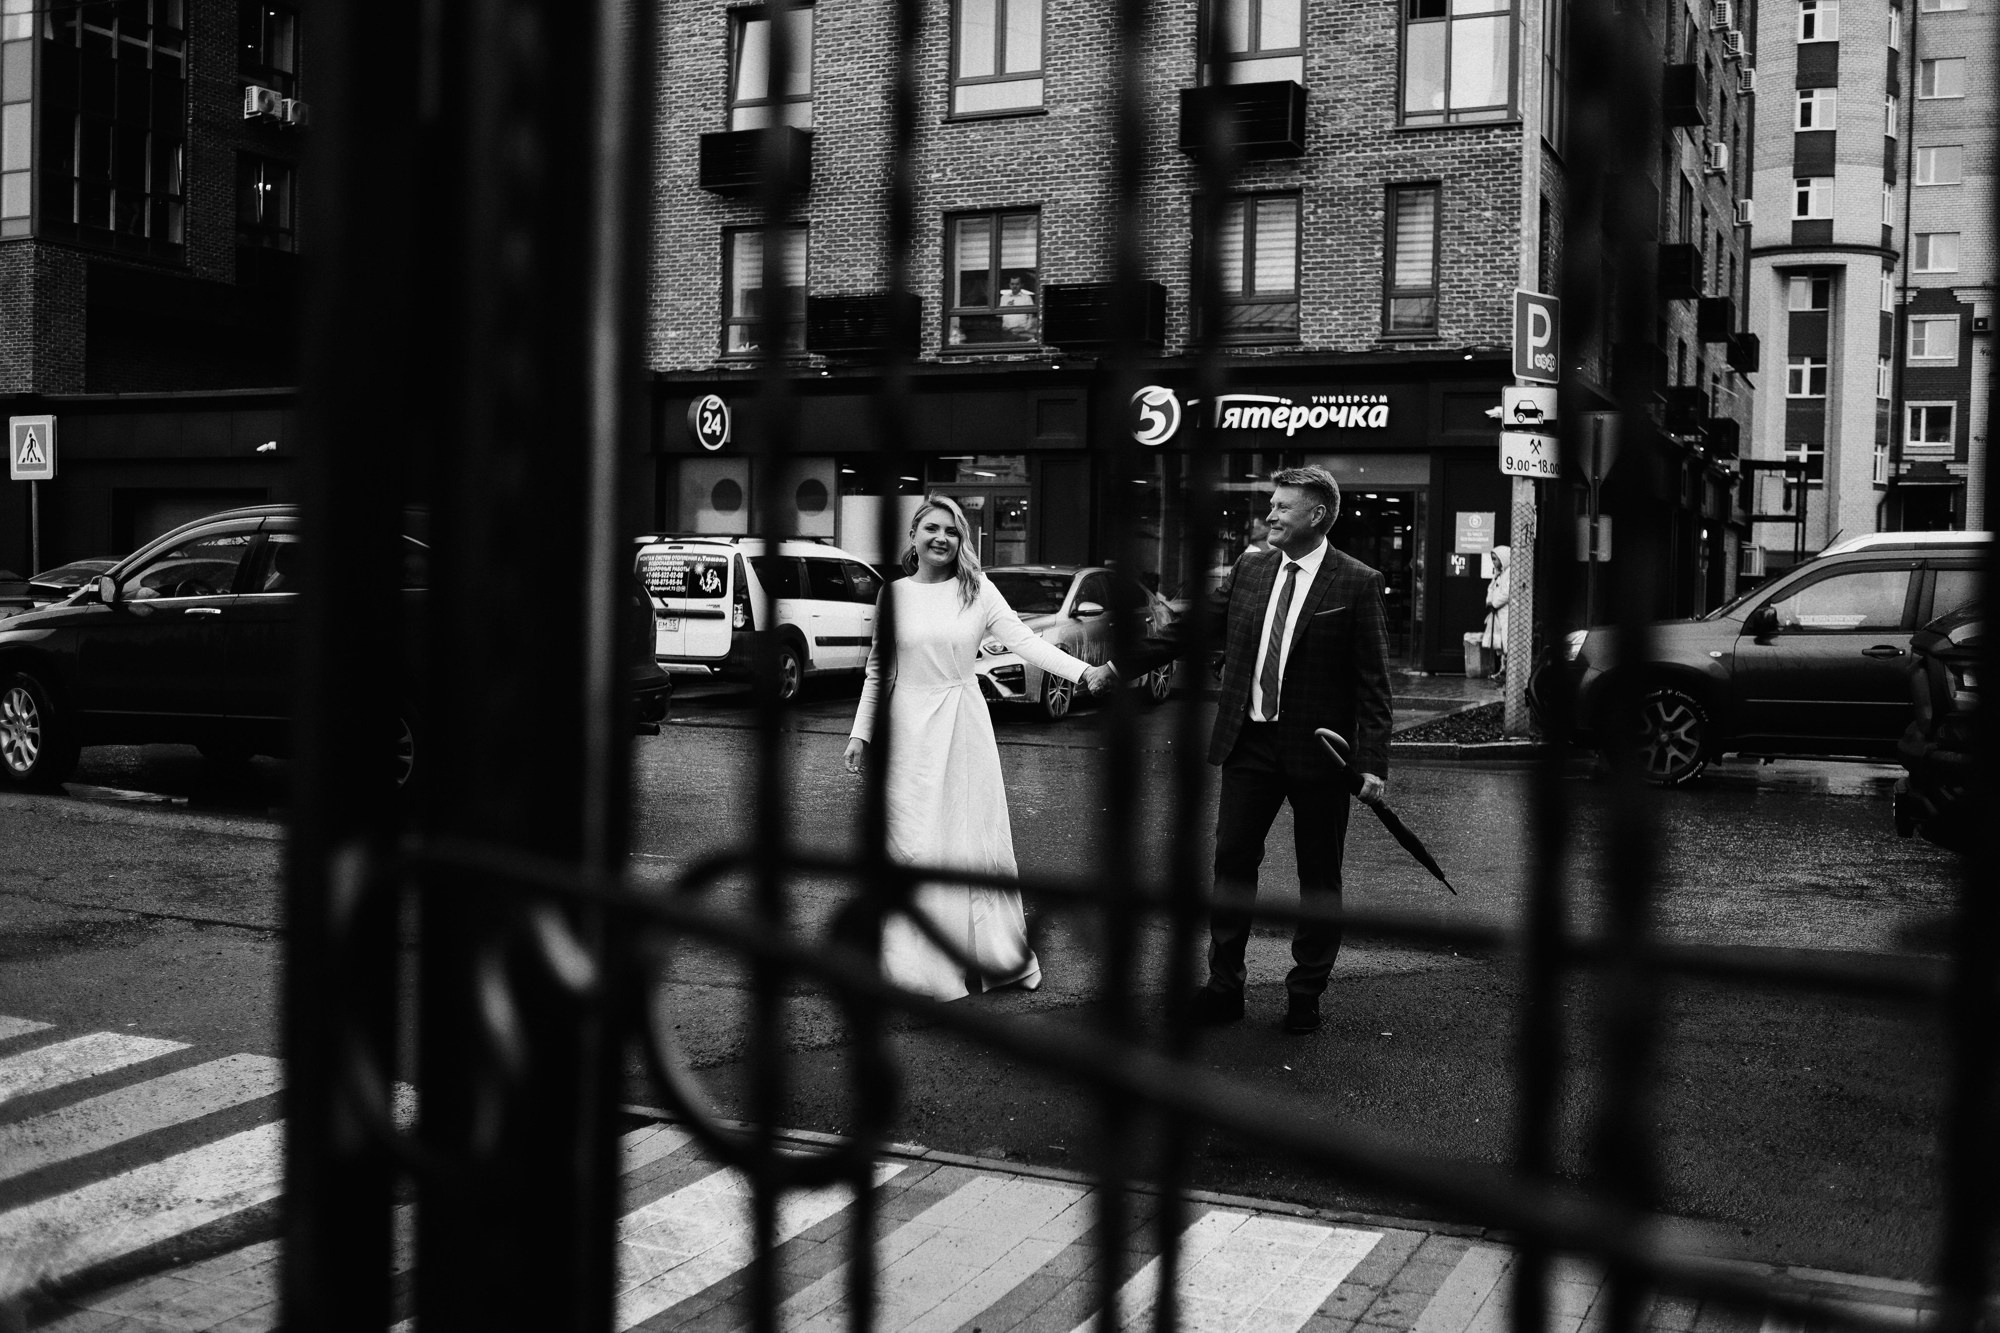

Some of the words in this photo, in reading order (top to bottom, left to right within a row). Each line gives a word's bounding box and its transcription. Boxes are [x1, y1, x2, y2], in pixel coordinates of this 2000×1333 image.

[1527, 302, 1552, 370] P
[1547, 357, 1556, 368] 20
[1311, 395, 1389, 404] УНИВЕРСАМ
[702, 410, 722, 436] 24
[1136, 390, 1175, 439] 5
